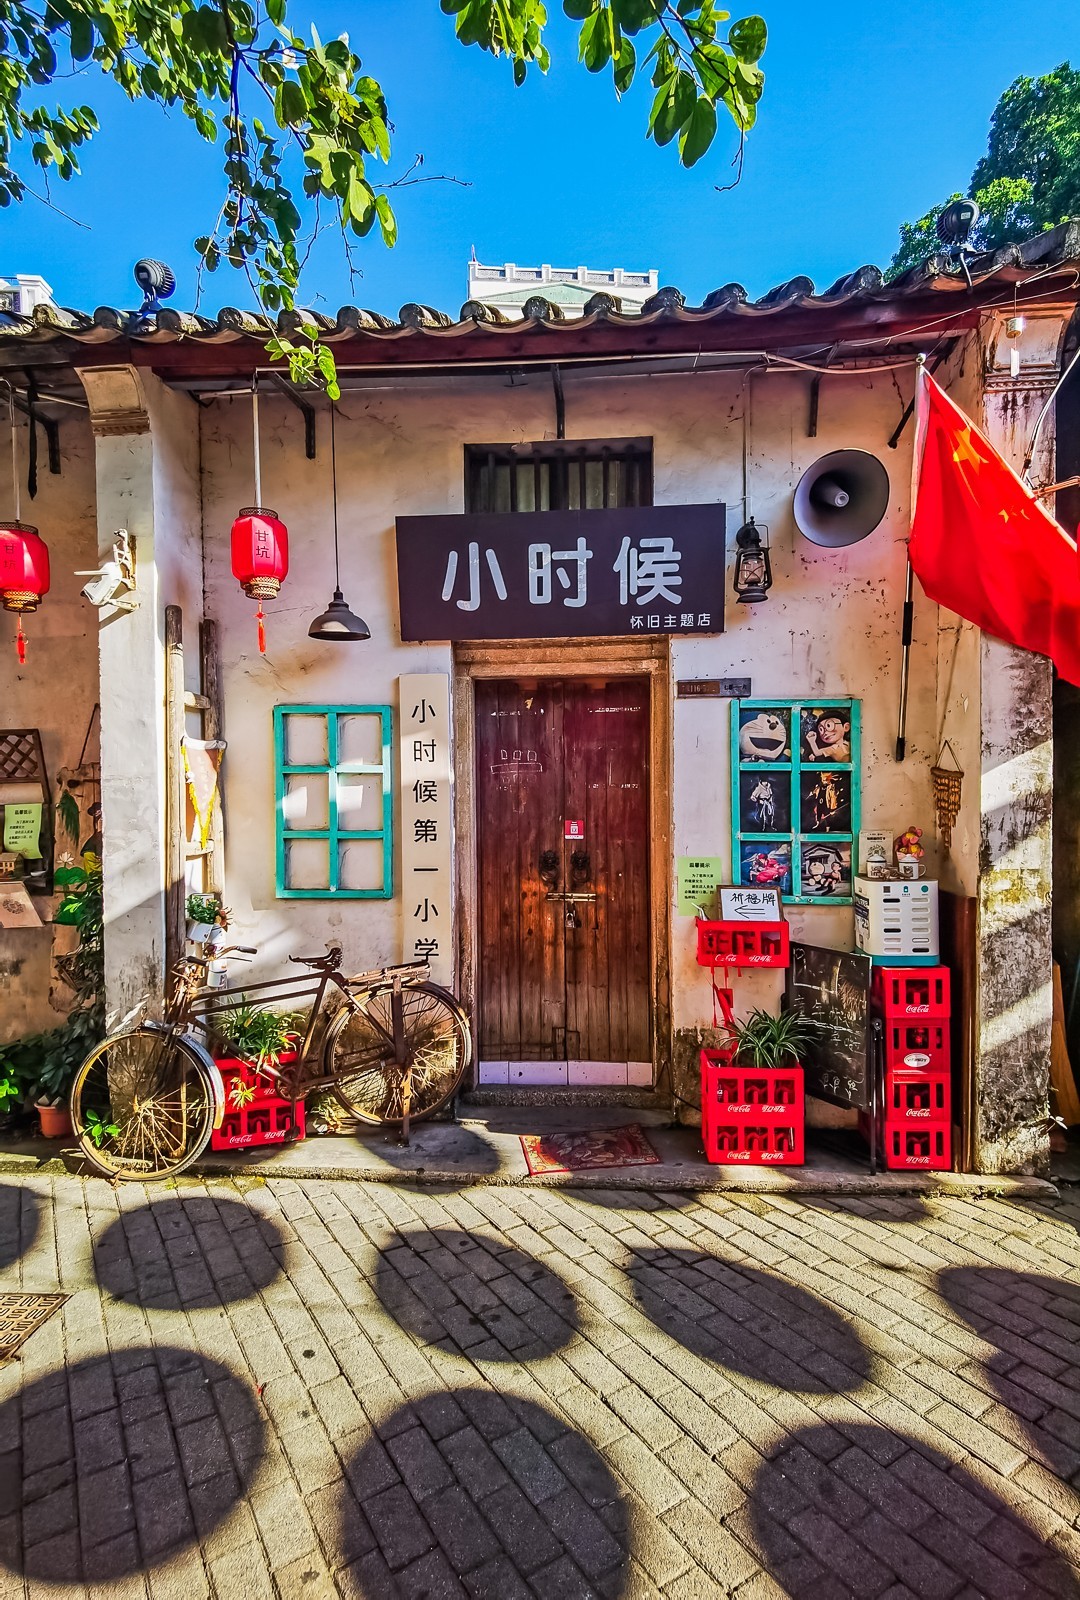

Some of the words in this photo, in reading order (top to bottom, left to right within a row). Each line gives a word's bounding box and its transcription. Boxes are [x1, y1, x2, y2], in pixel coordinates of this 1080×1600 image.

[255, 530, 270, 559] 甘坑
[441, 536, 683, 611] 小时候
[630, 613, 711, 629] 怀旧主题店
[411, 698, 439, 962] 小时候第一小学
[715, 953, 737, 962] CCola
